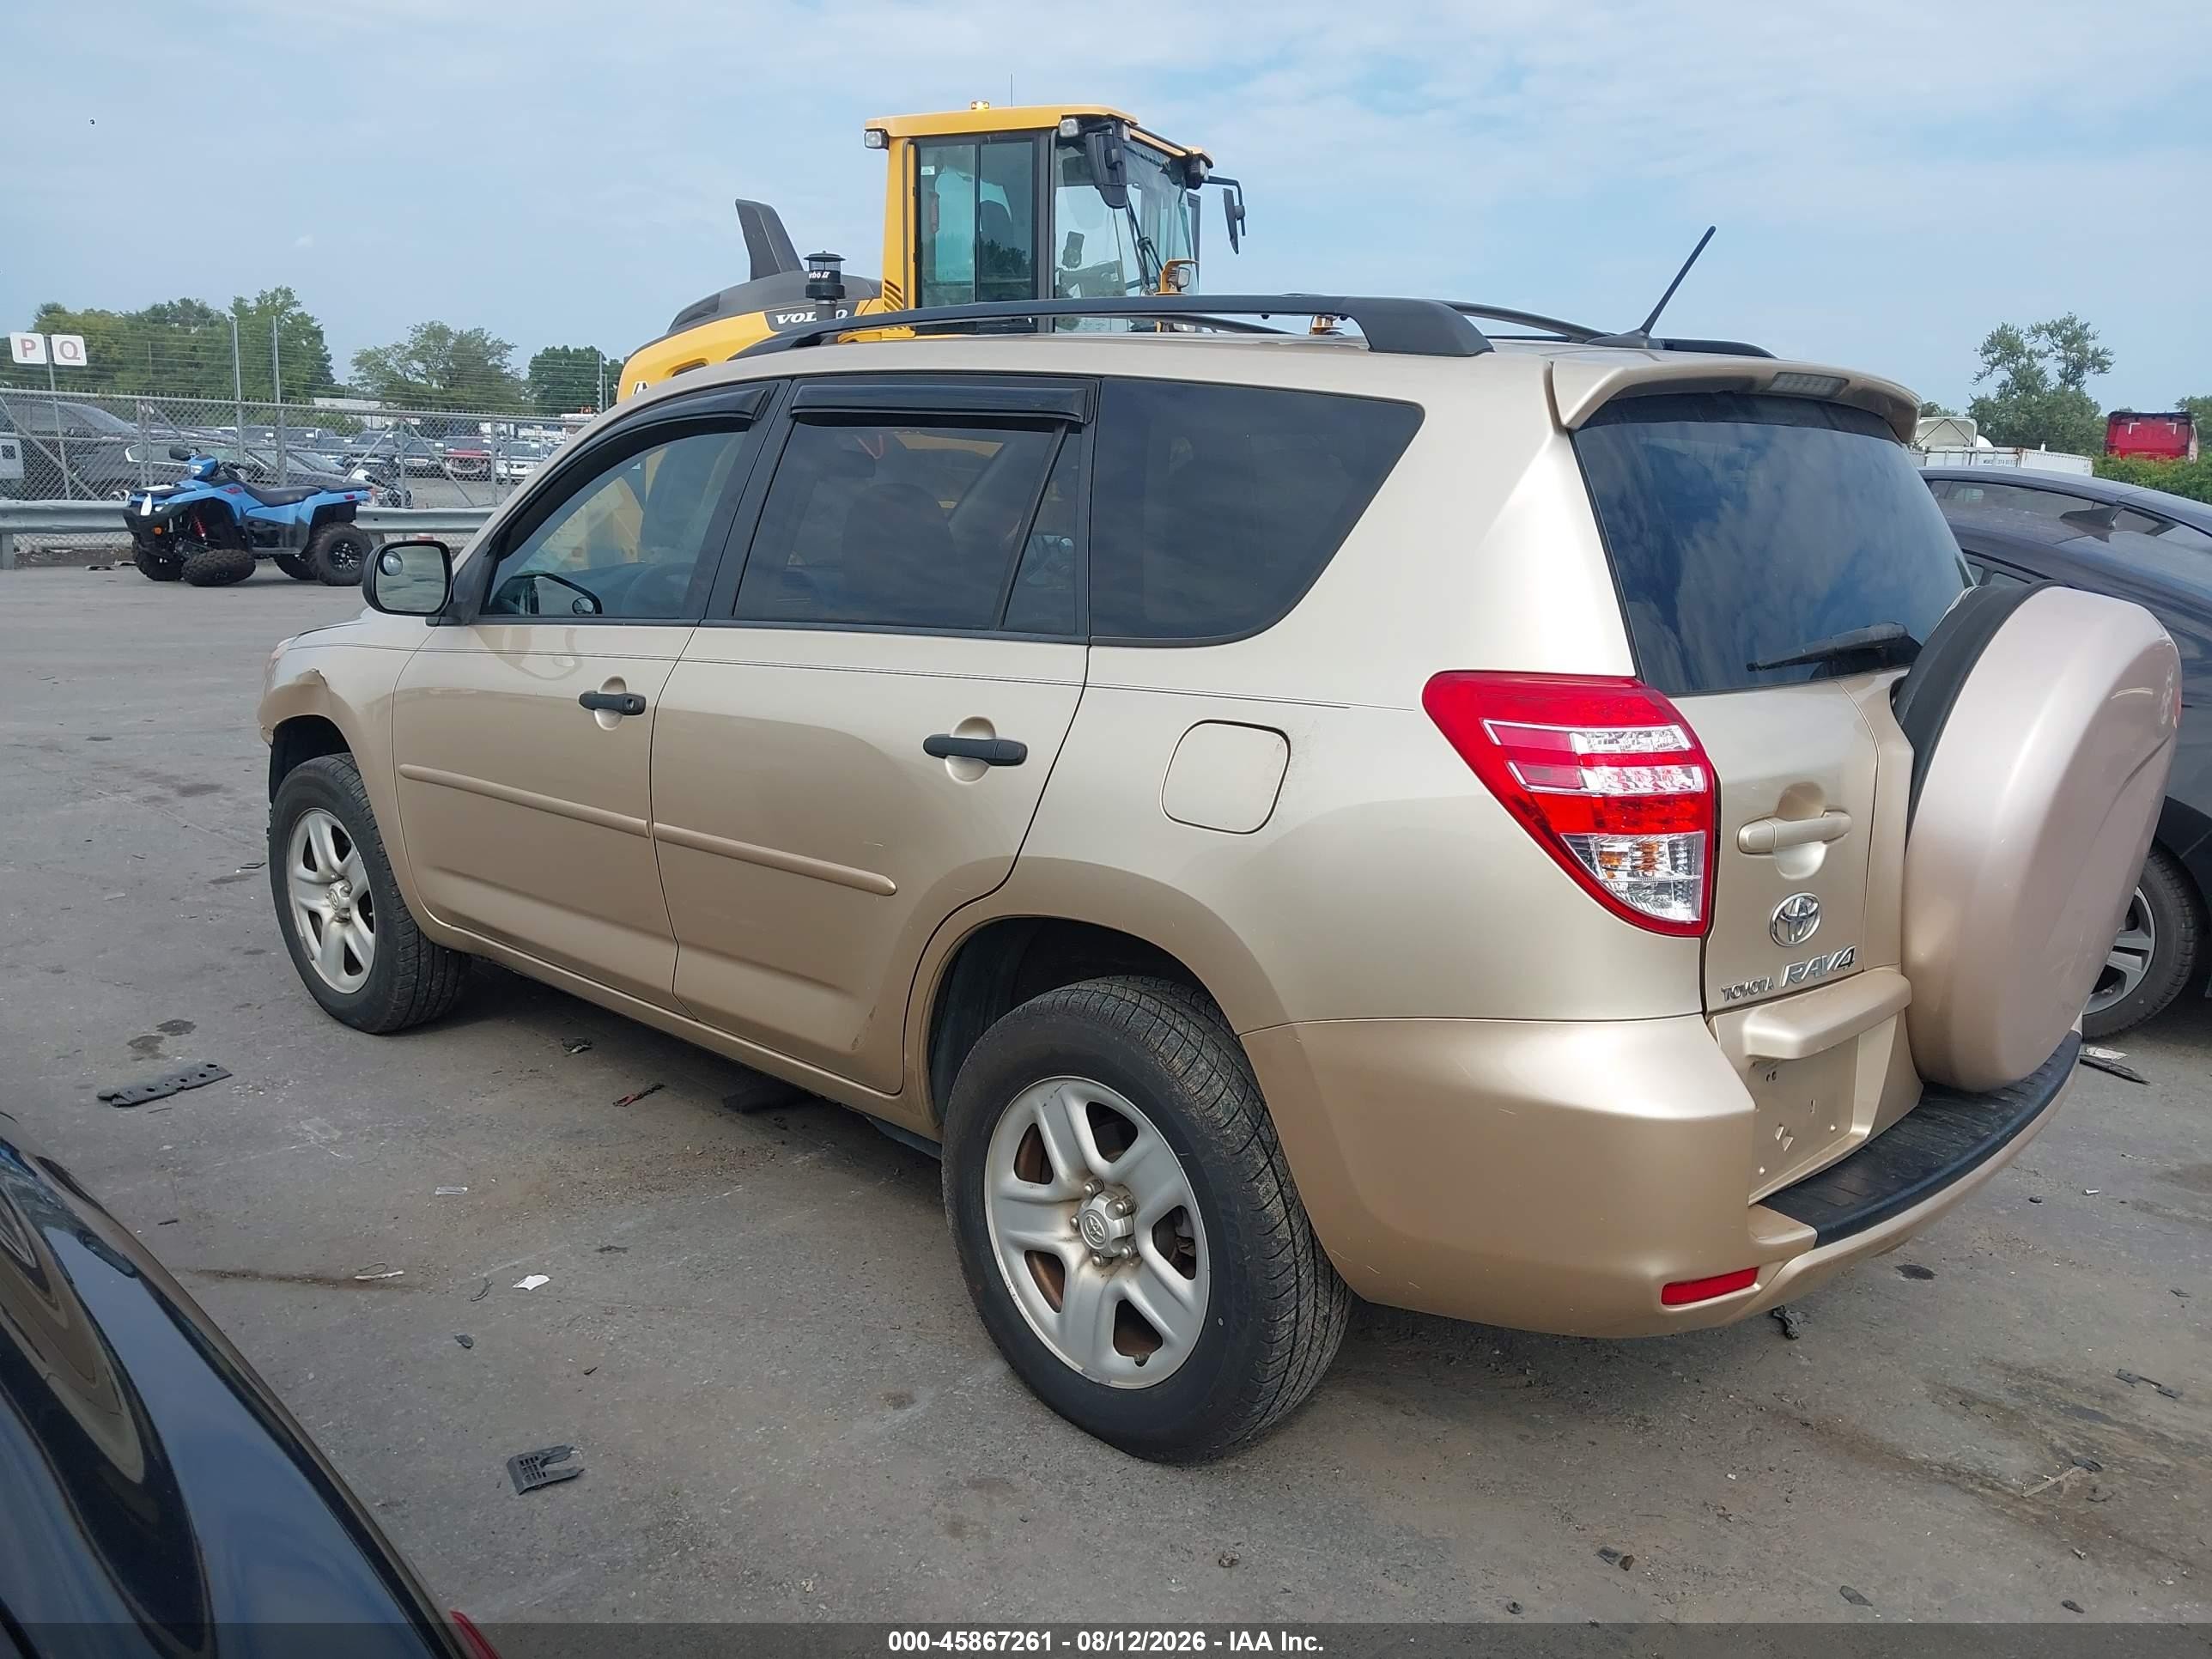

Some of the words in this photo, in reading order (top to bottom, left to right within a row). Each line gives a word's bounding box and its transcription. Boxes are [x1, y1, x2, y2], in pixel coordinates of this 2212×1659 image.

[775, 309, 848, 325] VOLO
[21, 338, 36, 358] P
[59, 340, 81, 361] Q
[1721, 976, 1775, 1002] TOYOTA
[1780, 945, 1856, 988] RAV4
